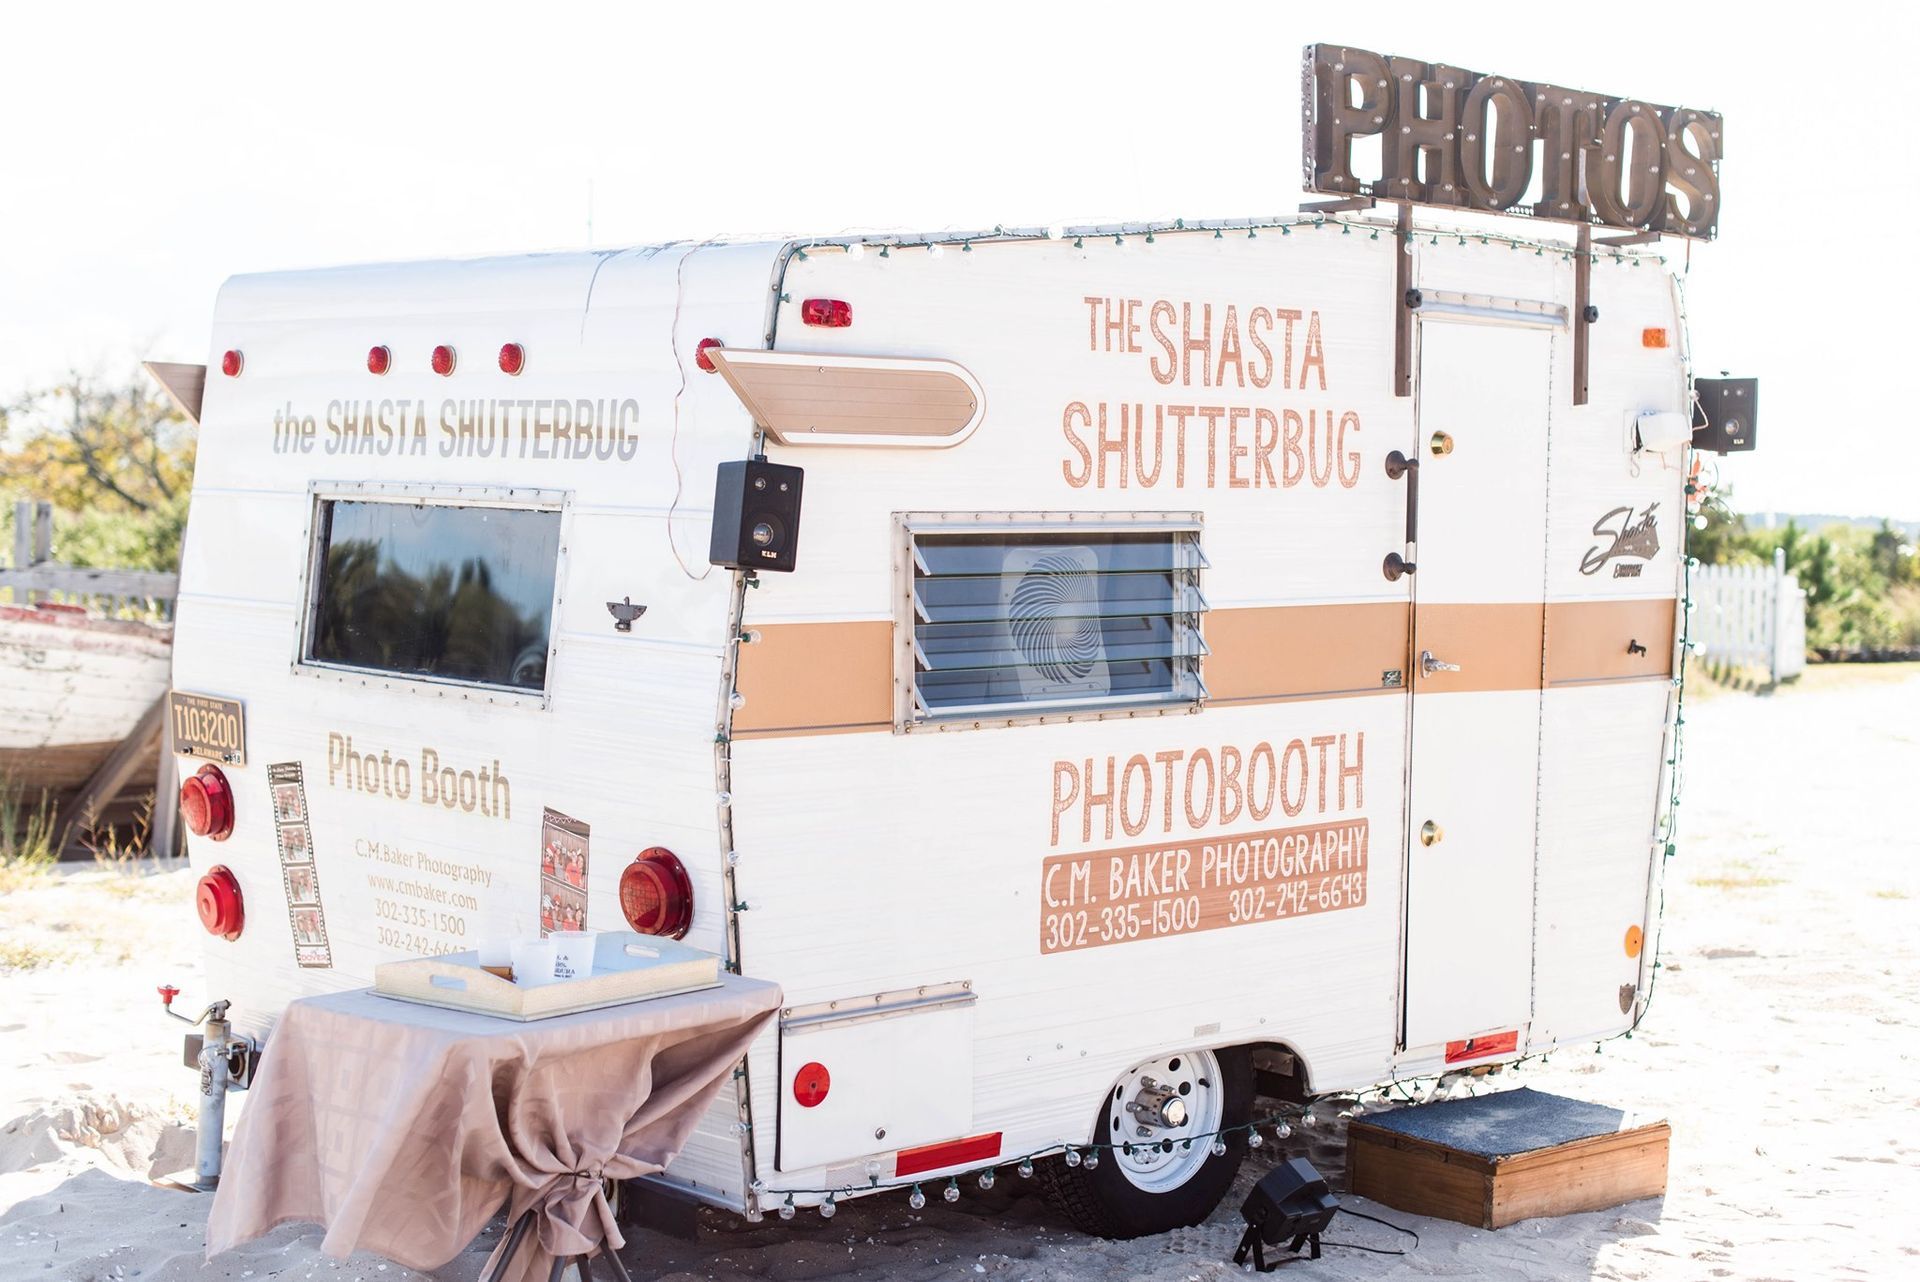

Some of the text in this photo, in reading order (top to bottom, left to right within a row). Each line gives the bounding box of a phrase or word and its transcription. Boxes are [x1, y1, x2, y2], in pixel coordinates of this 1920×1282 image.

[1308, 42, 1723, 241] PHOTOS
[1084, 296, 1327, 390] THE SHASTA
[272, 398, 640, 462] the SHASTA SHUTTERBUG
[1062, 401, 1361, 489] SHUTTERBUG
[174, 704, 238, 750] T103200
[328, 731, 511, 820] Photo Booth
[1050, 731, 1364, 847] PHOTOBOOTH
[368, 875, 478, 911] www.cmbaker.com
[417, 852, 492, 888] Photography
[1045, 825, 1366, 908] C.M. BAKER PHOTOGRAPHY
[375, 898, 465, 936] 302-335-1500
[377, 926, 467, 956] 302-242-66
[1046, 871, 1363, 950] 302-335-1500 302-242-6643
